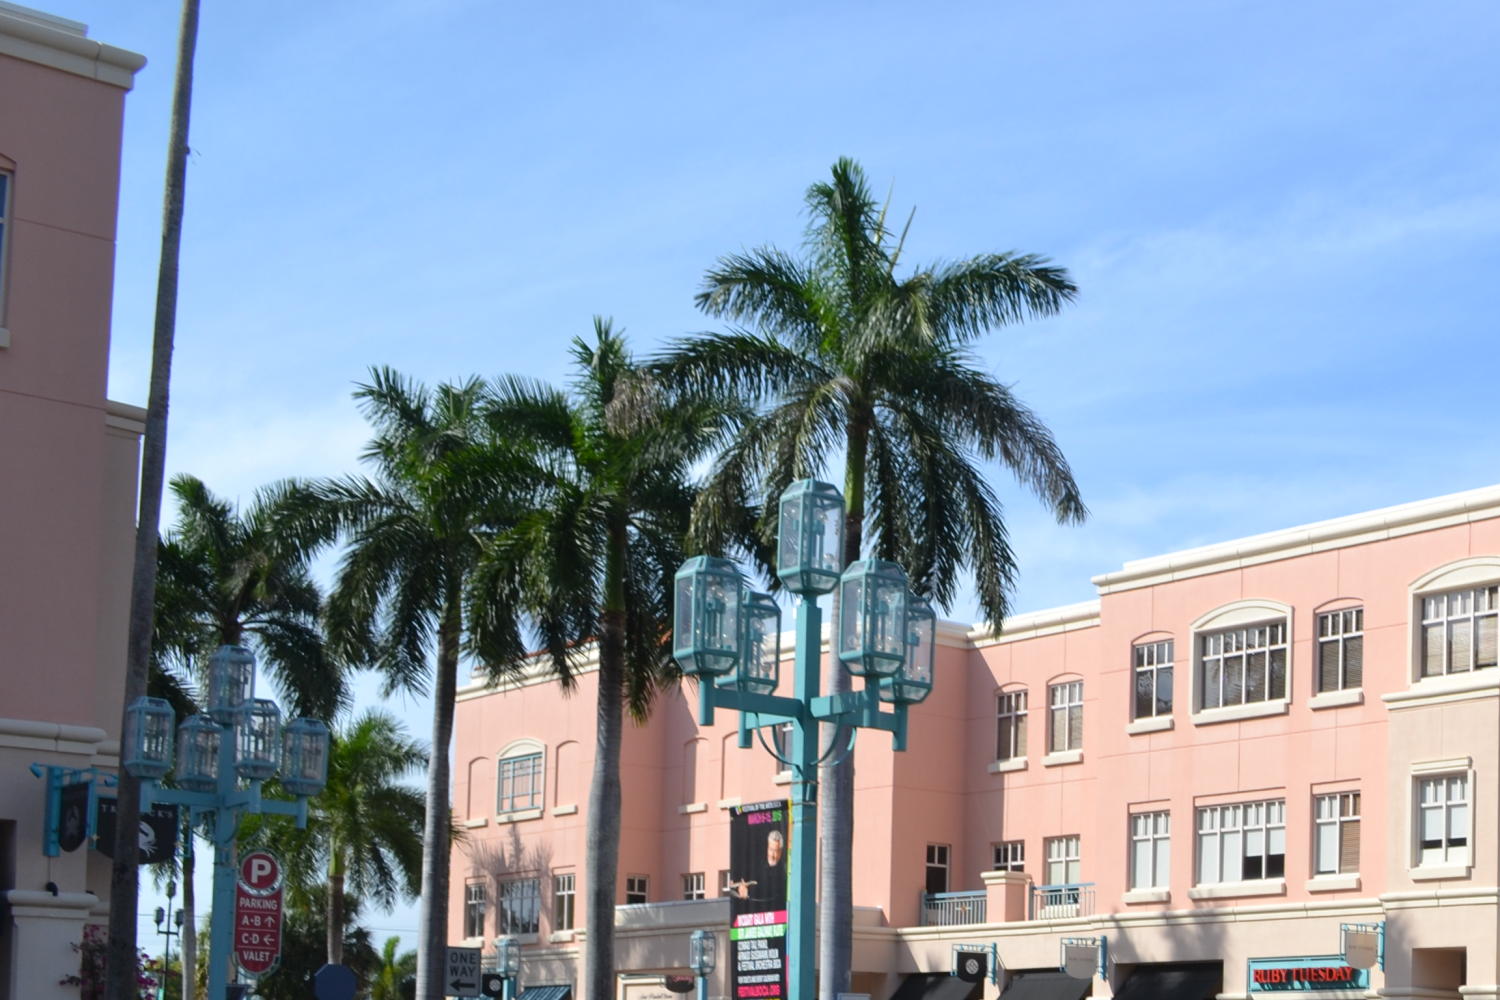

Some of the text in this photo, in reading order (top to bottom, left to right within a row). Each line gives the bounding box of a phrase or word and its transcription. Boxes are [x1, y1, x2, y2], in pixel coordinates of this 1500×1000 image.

[250, 858, 272, 884] P
[239, 897, 279, 911] PARKING
[242, 951, 271, 961] VALET
[450, 952, 477, 965] ONE
[449, 966, 477, 977] WAY
[1253, 966, 1354, 984] RUBY TUESDAY
